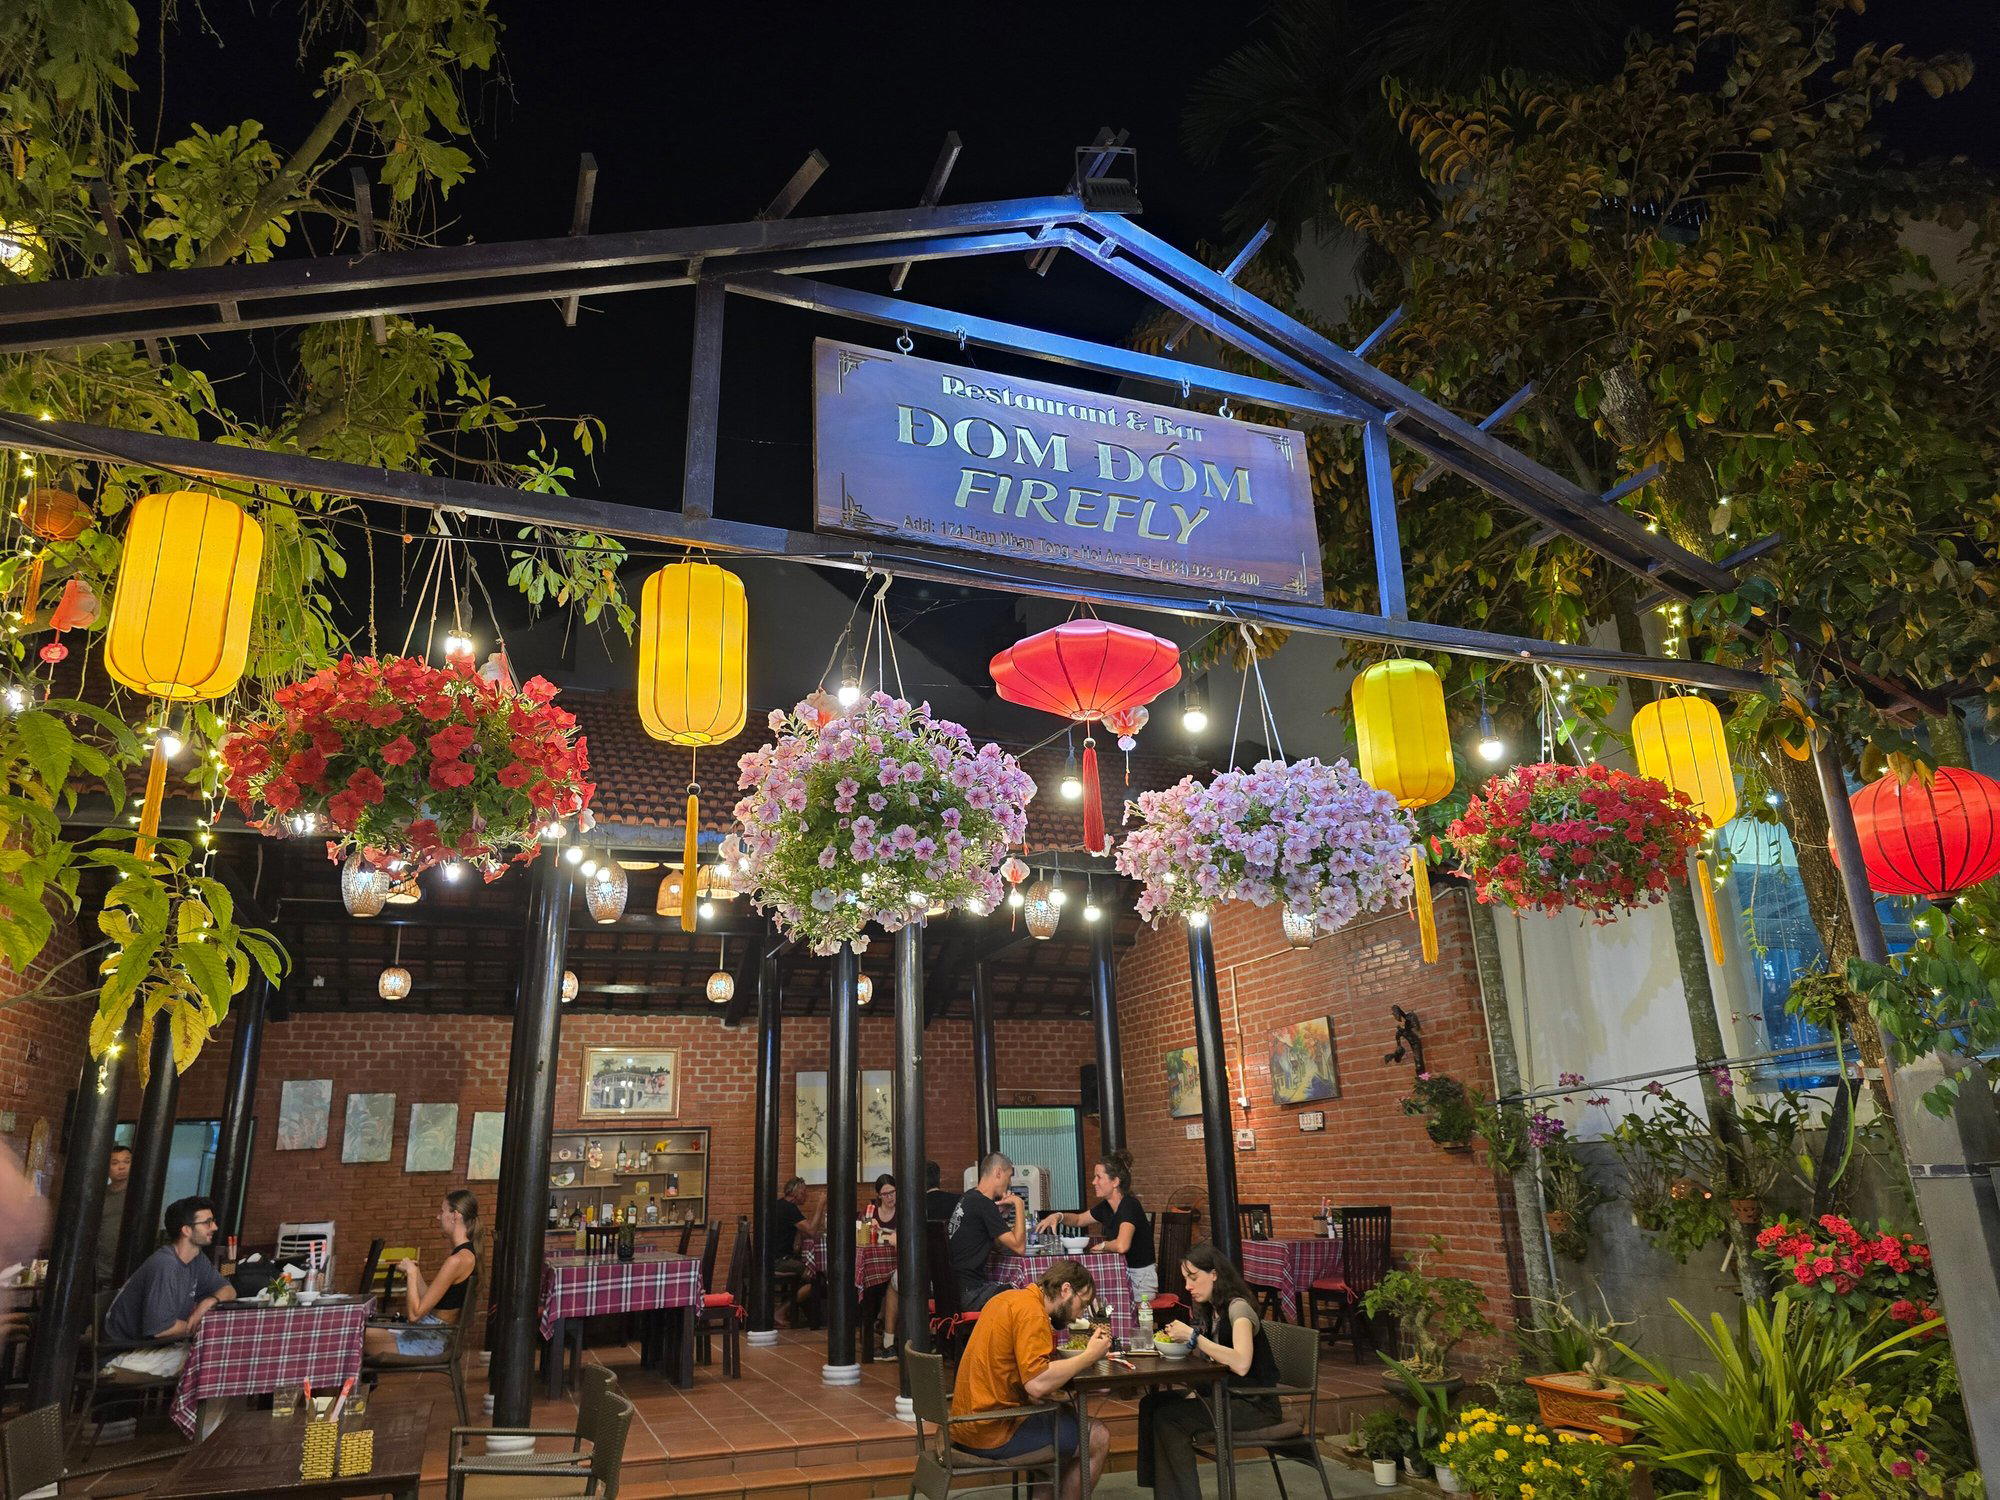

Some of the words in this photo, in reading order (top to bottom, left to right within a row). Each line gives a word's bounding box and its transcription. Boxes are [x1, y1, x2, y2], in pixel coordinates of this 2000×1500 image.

[942, 373, 1121, 427] Restaurant
[1125, 410, 1148, 432] &
[1154, 415, 1207, 442] Bar
[895, 403, 1073, 473] ĐOM
[1094, 440, 1256, 505] ĐÓM
[955, 467, 1210, 545] FIREFLY
[903, 515, 935, 534] Add:
[941, 520, 964, 536] 174
[967, 525, 996, 544] Tran
[1000, 530, 1034, 551] Nhan
[1038, 537, 1069, 559] Tong
[1105, 547, 1122, 564] An
[1216, 567, 1237, 582] 475
[1240, 570, 1260, 586] 400
